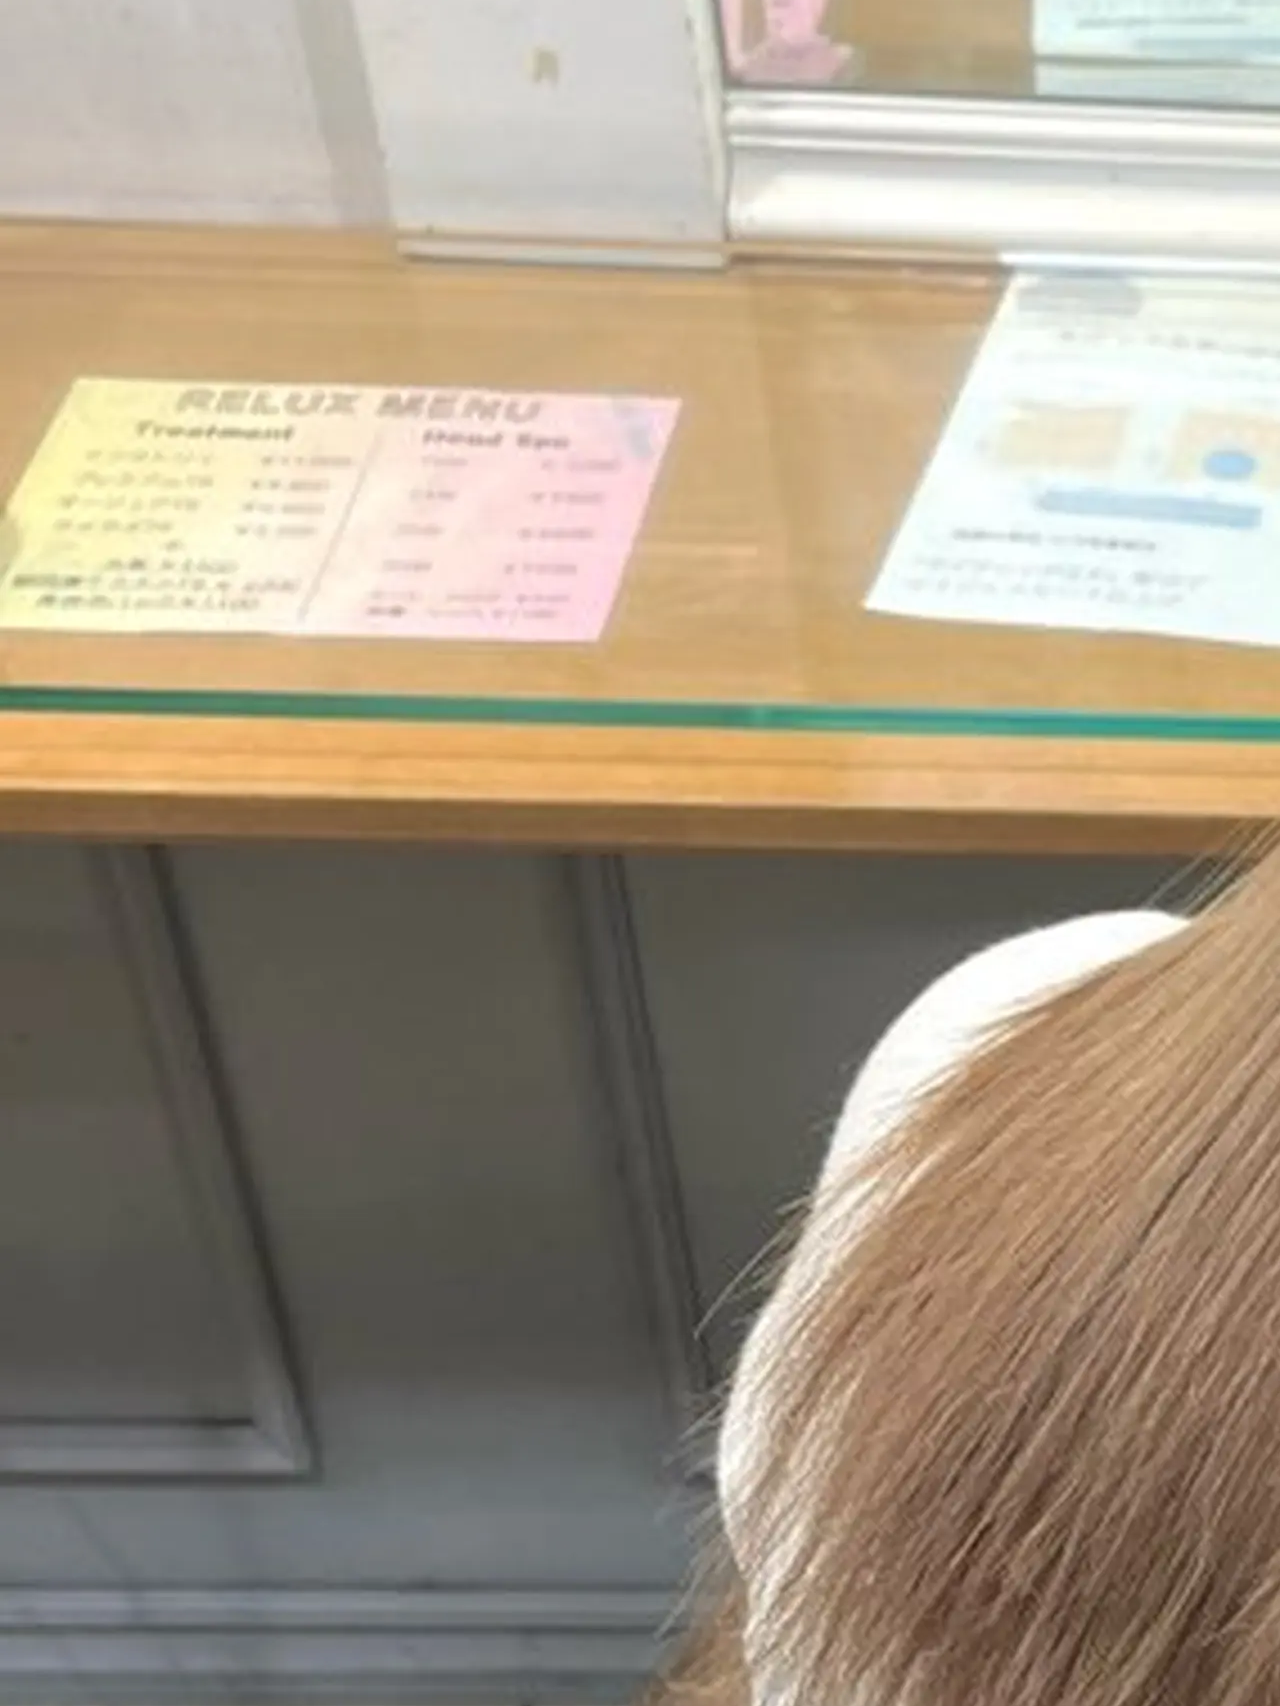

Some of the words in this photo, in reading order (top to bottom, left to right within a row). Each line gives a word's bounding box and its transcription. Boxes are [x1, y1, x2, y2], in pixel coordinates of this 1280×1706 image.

[175, 388, 361, 416] RELUX
[376, 394, 542, 423] MENU
[136, 420, 296, 440] Treatment
